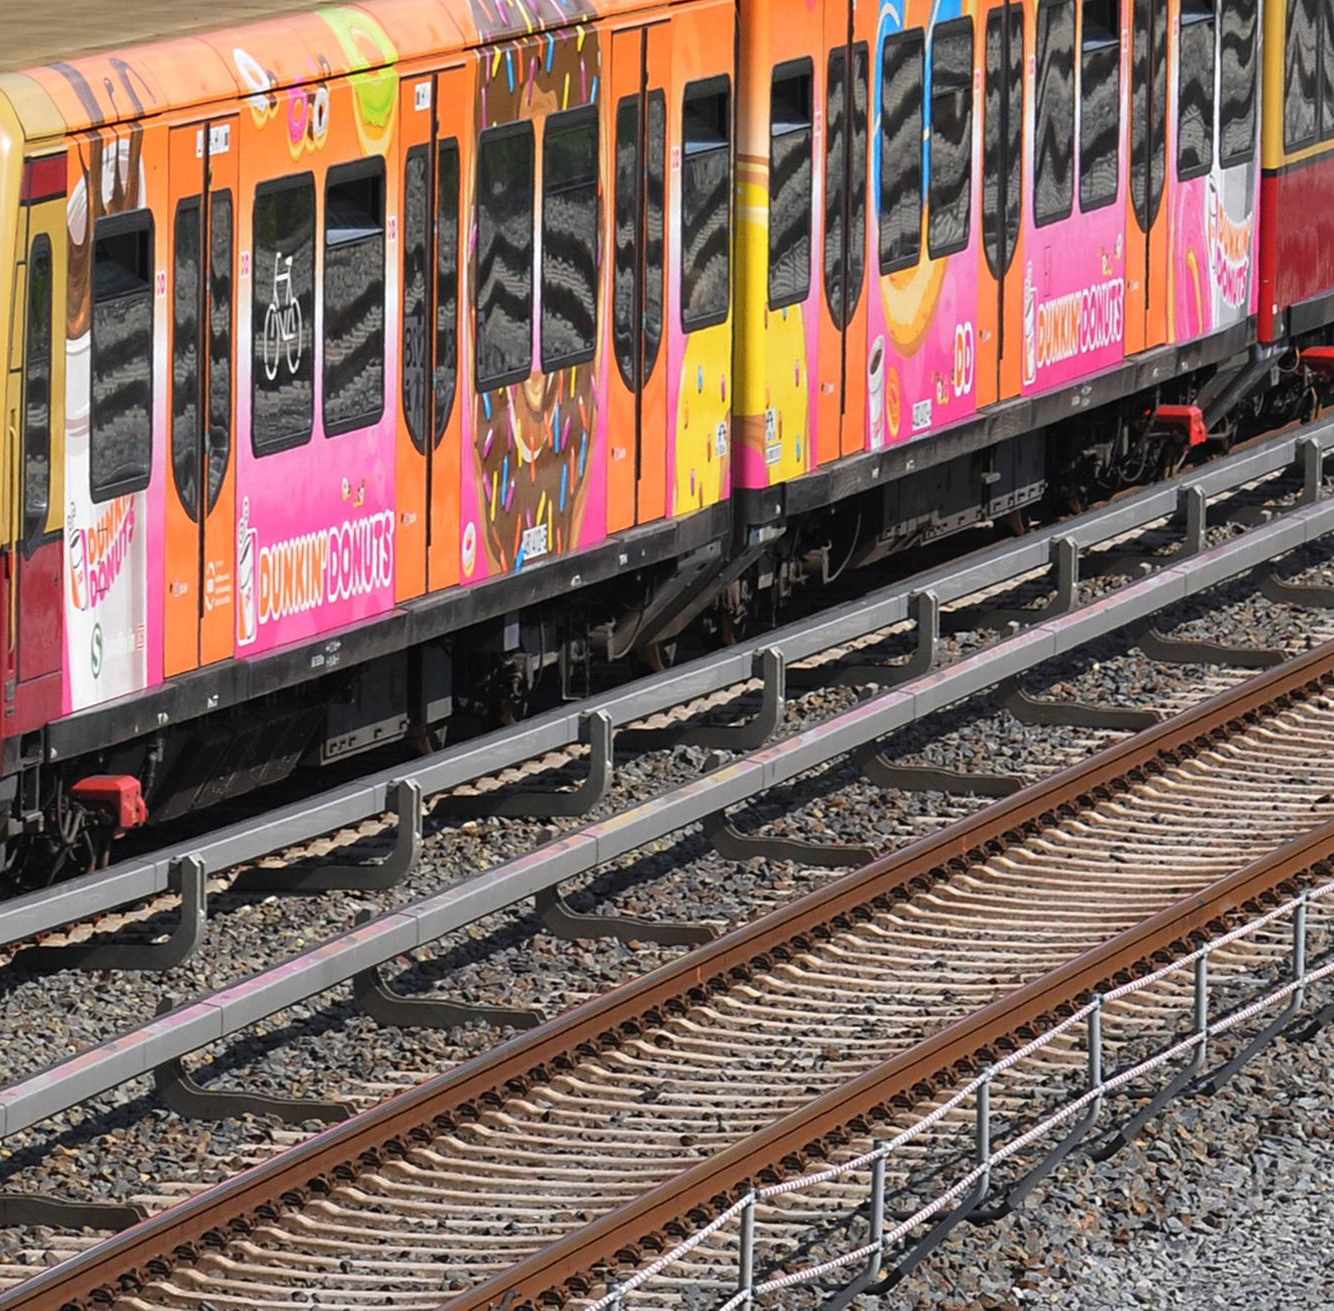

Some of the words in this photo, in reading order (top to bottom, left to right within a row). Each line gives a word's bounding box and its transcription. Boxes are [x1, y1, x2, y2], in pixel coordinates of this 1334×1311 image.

[1080, 278, 1124, 352] DONUTS
[89, 509, 136, 608] DONUTS
[328, 509, 395, 603] DONUTS
